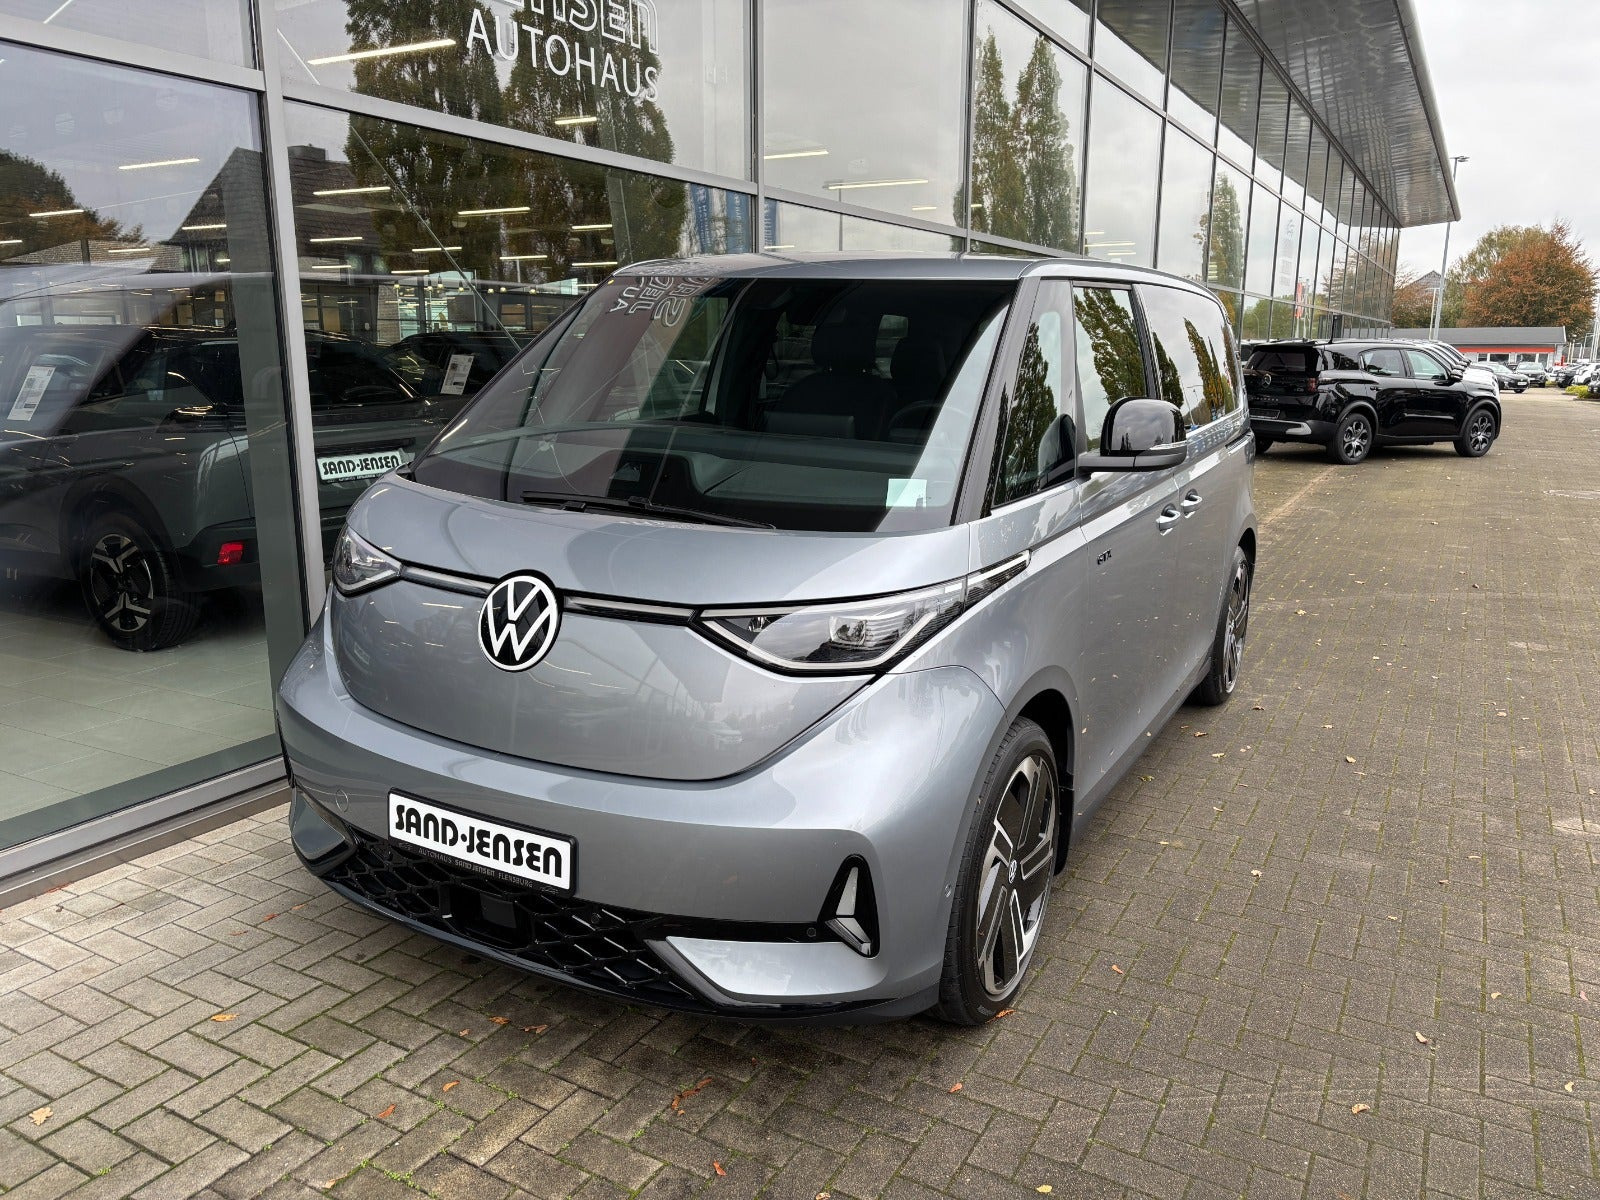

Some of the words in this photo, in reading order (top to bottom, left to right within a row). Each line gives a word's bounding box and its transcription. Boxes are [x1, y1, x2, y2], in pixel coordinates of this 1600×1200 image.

[466, 8, 659, 102] AUTOHAUS
[418, 847, 452, 865] AUTOHAUS
[498, 872, 534, 889] FLENSBURG
